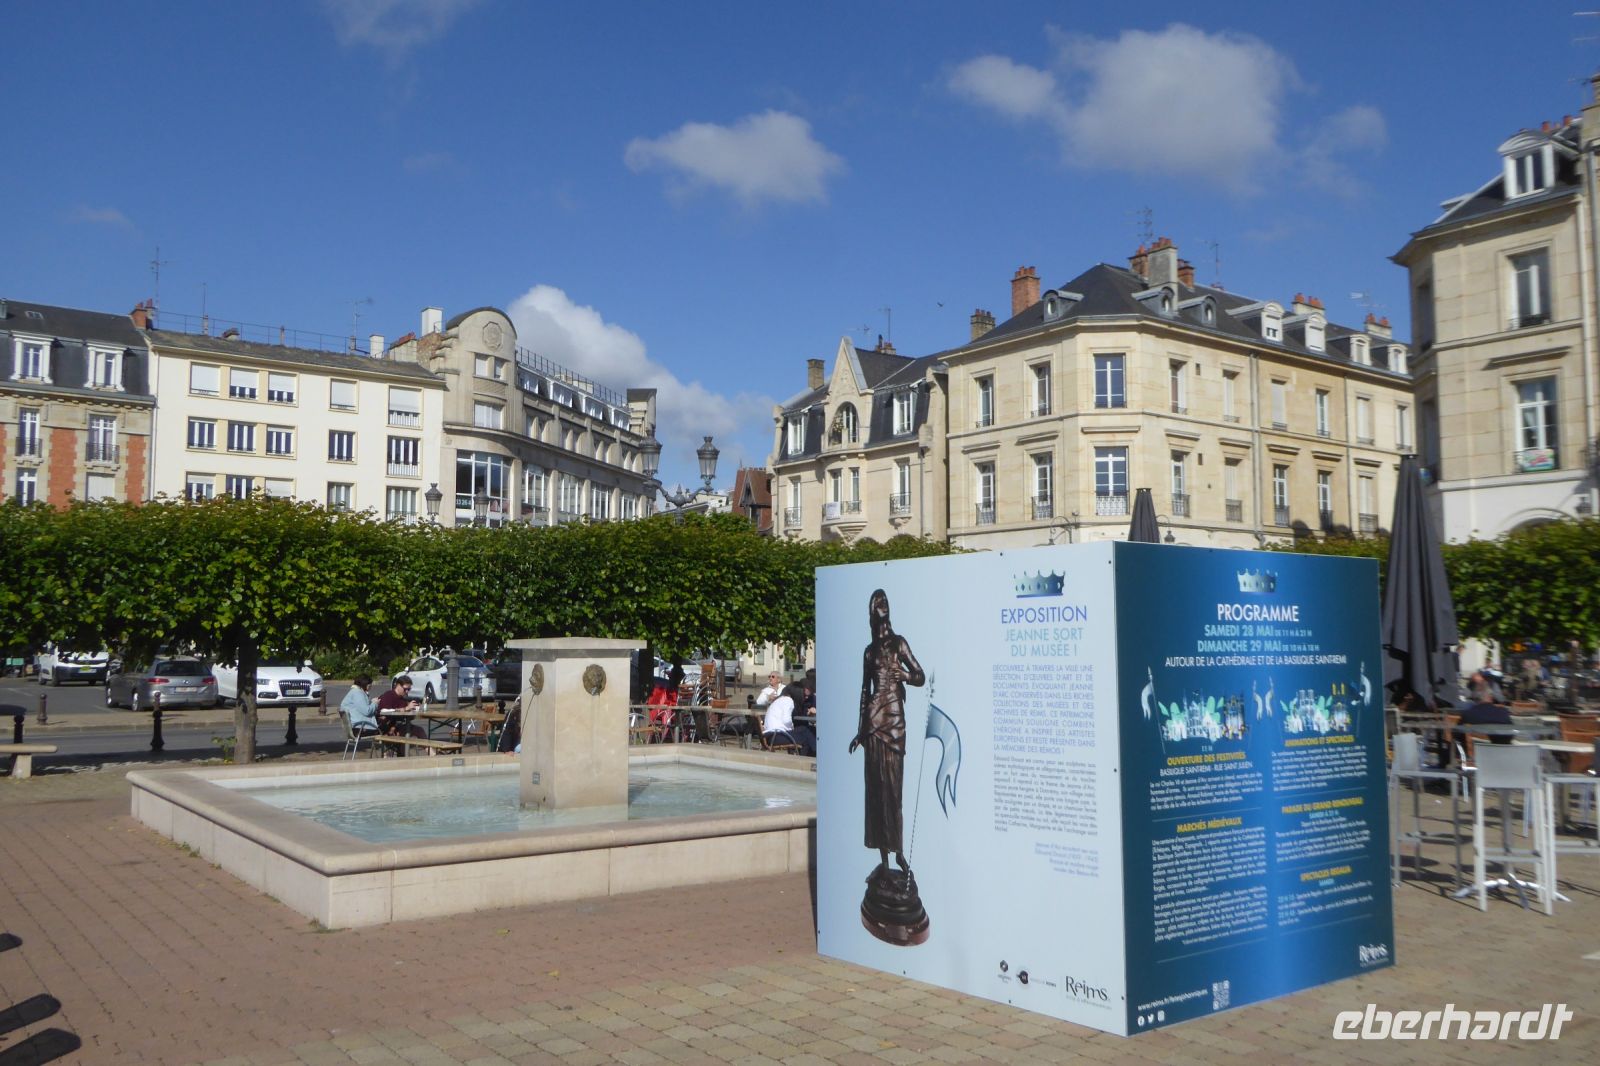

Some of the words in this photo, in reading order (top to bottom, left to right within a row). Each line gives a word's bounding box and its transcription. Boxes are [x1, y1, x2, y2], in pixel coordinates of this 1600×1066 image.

[1001, 606, 1088, 624] EXPOSITION
[1216, 604, 1299, 622] PROGRAMME
[1005, 628, 1050, 642] JEANNE
[1053, 628, 1084, 641] SORT
[1204, 624, 1240, 637] SAMEDI
[1242, 624, 1254, 637] 28
[1256, 624, 1274, 637] MAI
[1011, 645, 1026, 656] DU
[1031, 640, 1069, 656] MUSÉE
[1198, 640, 1248, 652] DIMANCHE
[1250, 640, 1261, 652] 29
[1264, 640, 1281, 652] MAI
[1164, 656, 1194, 667] AUTOUR
[1196, 656, 1205, 666] DE
[1206, 656, 1215, 666] LA
[1216, 653, 1256, 666] CATHÉDRALE
[1257, 655, 1264, 665] ET
[1266, 655, 1274, 665] DE
[1275, 655, 1283, 665] LA
[1284, 655, 1314, 665] BASILIQUE
[1066, 975, 1108, 1002] Reims
